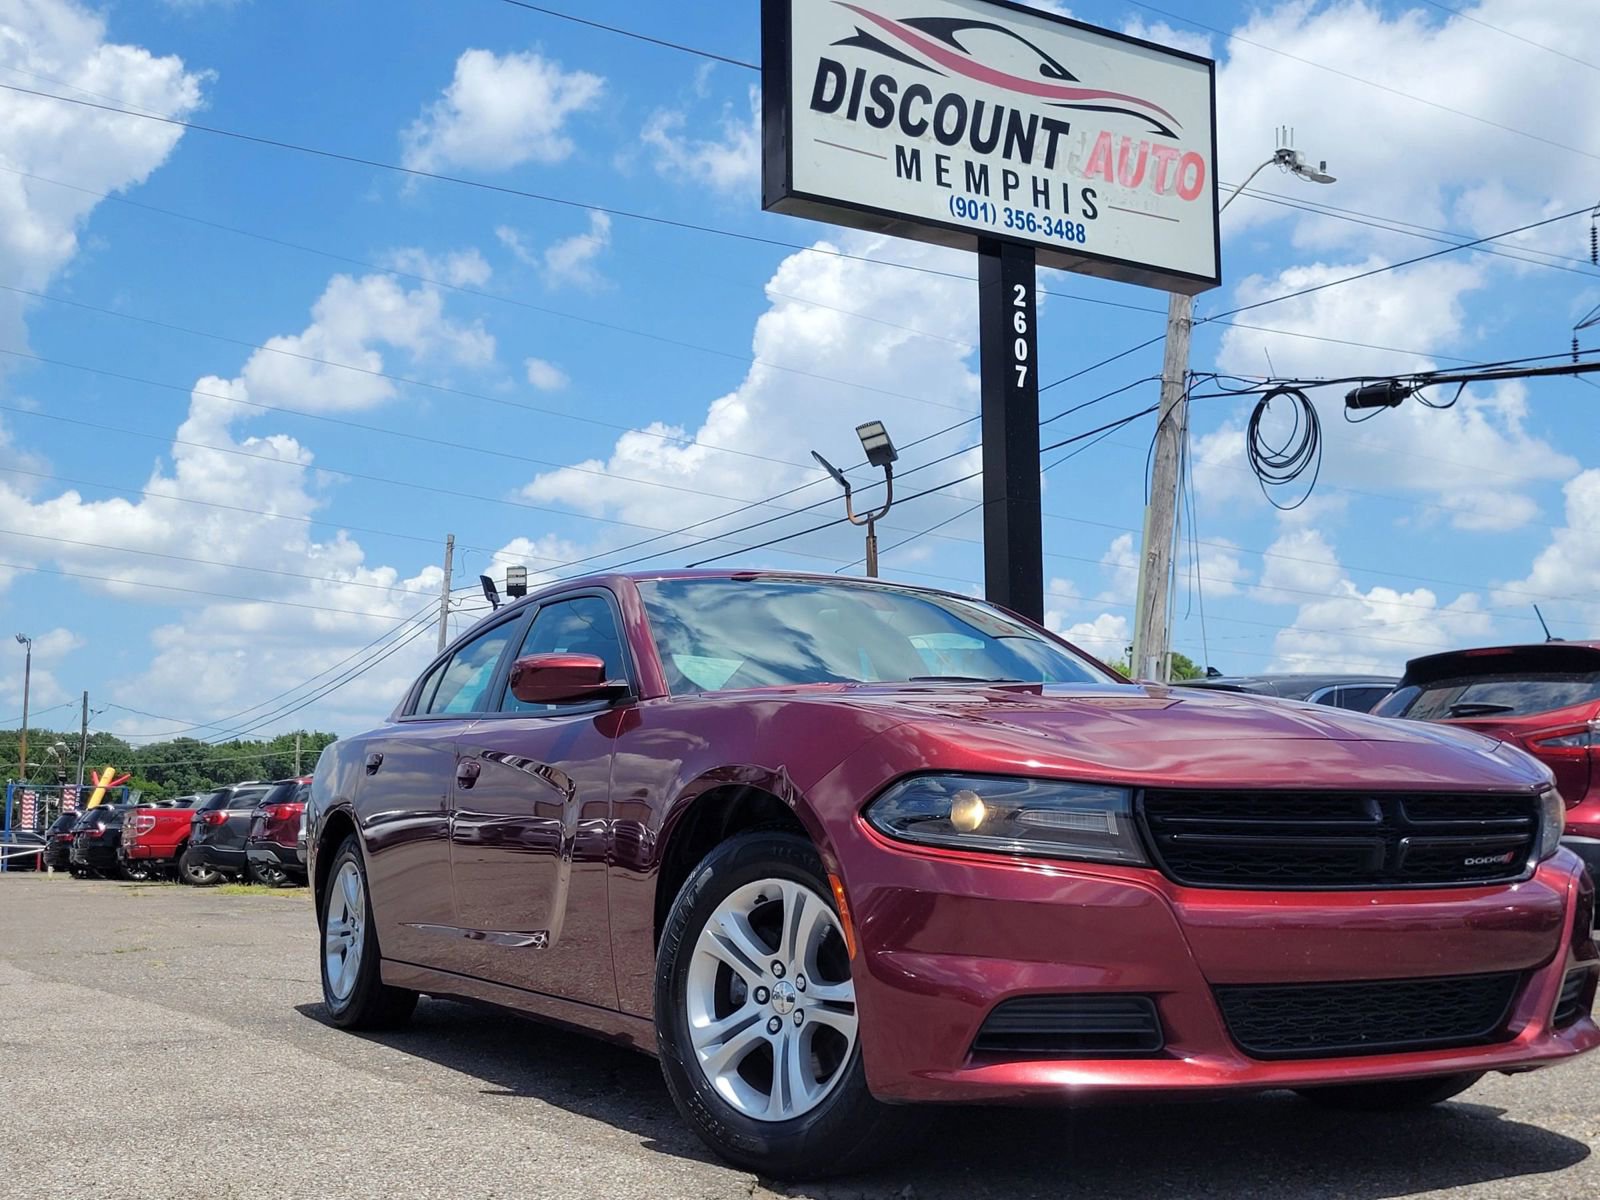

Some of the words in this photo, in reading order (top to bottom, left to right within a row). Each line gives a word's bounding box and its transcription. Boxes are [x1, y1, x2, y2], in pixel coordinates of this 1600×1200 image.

[809, 56, 1070, 170] DISCOUNT
[1083, 130, 1206, 201] AUTO
[895, 144, 1098, 220] MEMPHIS
[949, 194, 997, 226] (901)
[1003, 207, 1087, 244] 356-3488
[1013, 284, 1028, 388] 2607
